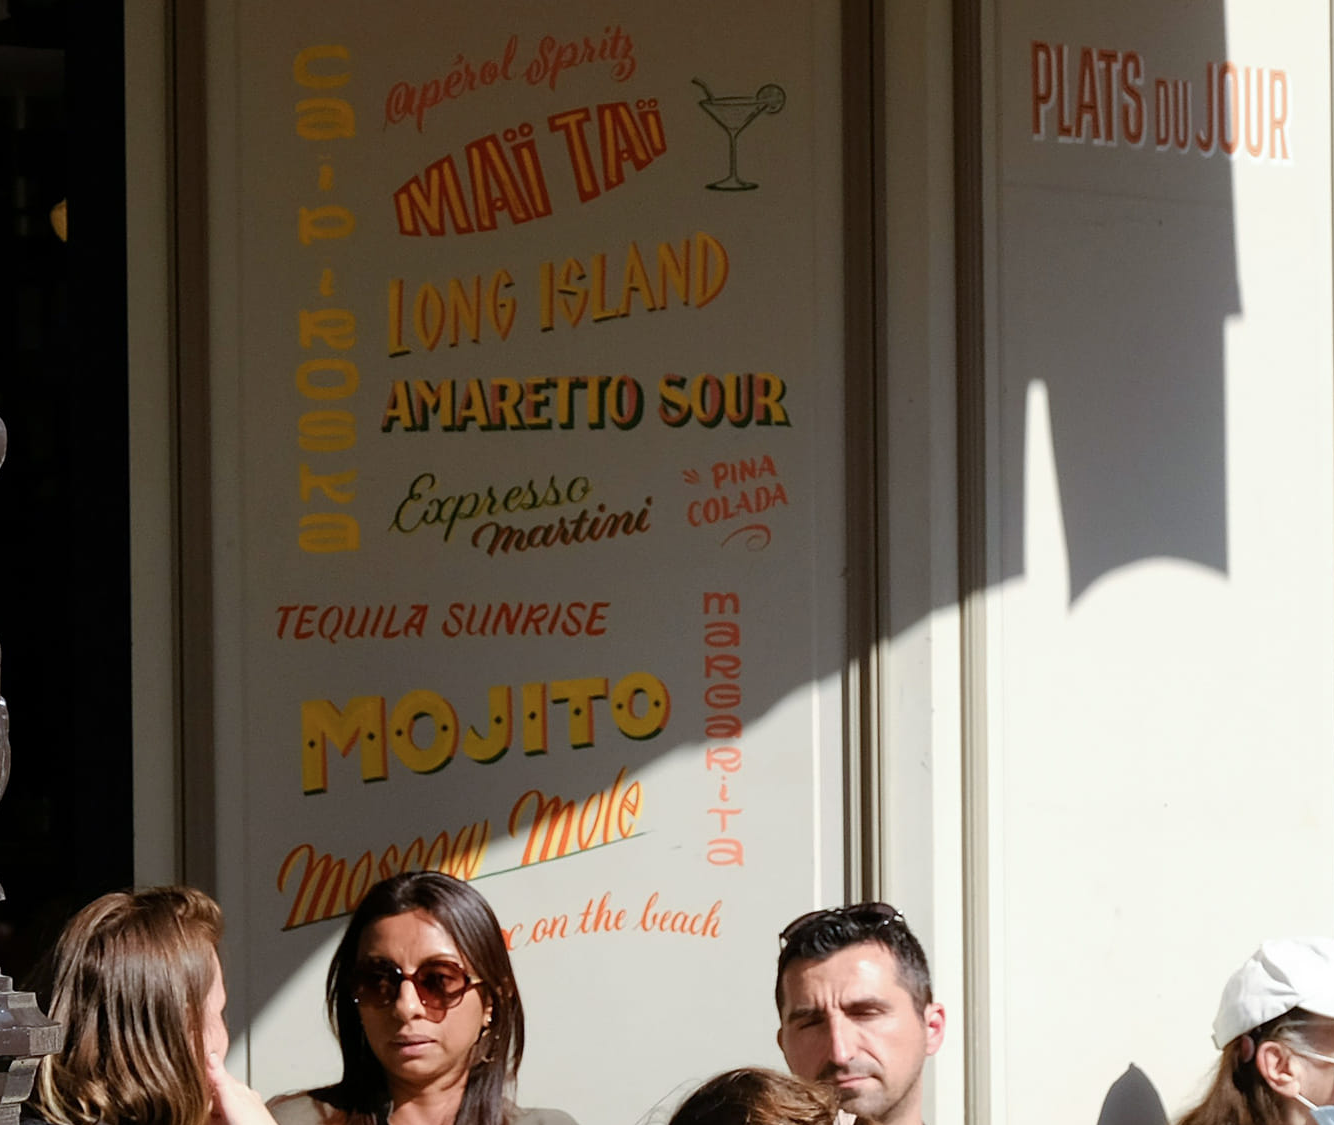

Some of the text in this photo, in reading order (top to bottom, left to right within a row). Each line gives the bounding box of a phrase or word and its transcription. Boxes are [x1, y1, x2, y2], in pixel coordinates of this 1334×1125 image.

[523, 26, 637, 91] Spritz
[1031, 39, 1292, 165] PLATS DU JOUR
[388, 231, 730, 358] LONG ISLAND
[382, 372, 793, 432] AMARETTO SOUR
[711, 454, 779, 490] PINA
[388, 472, 593, 543] Expresso
[686, 482, 789, 528] COLADA
[275, 602, 611, 644] TEQUILA SUNRISE
[300, 671, 671, 796] MOJITO
[524, 914, 570, 948] on
[573, 890, 628, 935] the
[631, 890, 724, 939] beach
